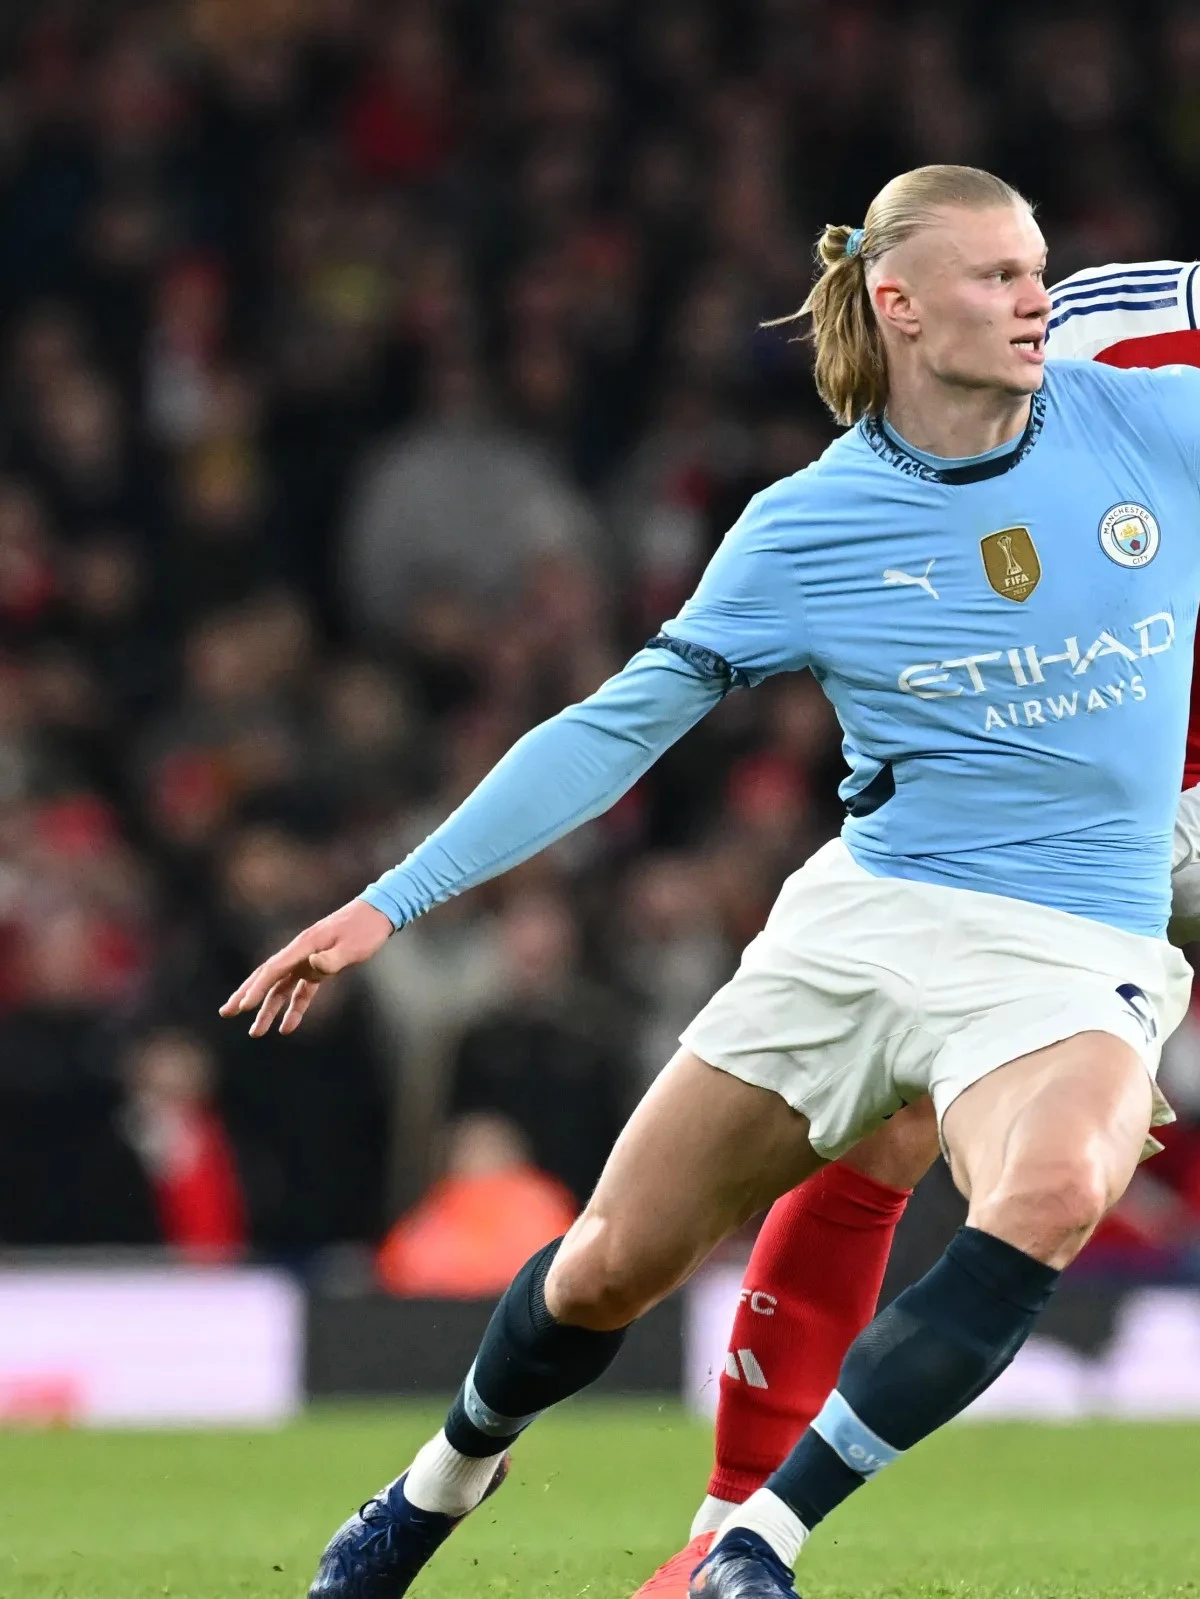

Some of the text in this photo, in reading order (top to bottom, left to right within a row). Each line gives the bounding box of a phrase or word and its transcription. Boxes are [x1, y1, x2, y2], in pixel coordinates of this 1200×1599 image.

[1103, 506, 1150, 535] MANCHESTER
[1132, 555, 1148, 565] CITY
[1004, 573, 1030, 588] FIFA
[898, 611, 1175, 699] ETIHAD
[984, 675, 1147, 732] AIRWAYS
